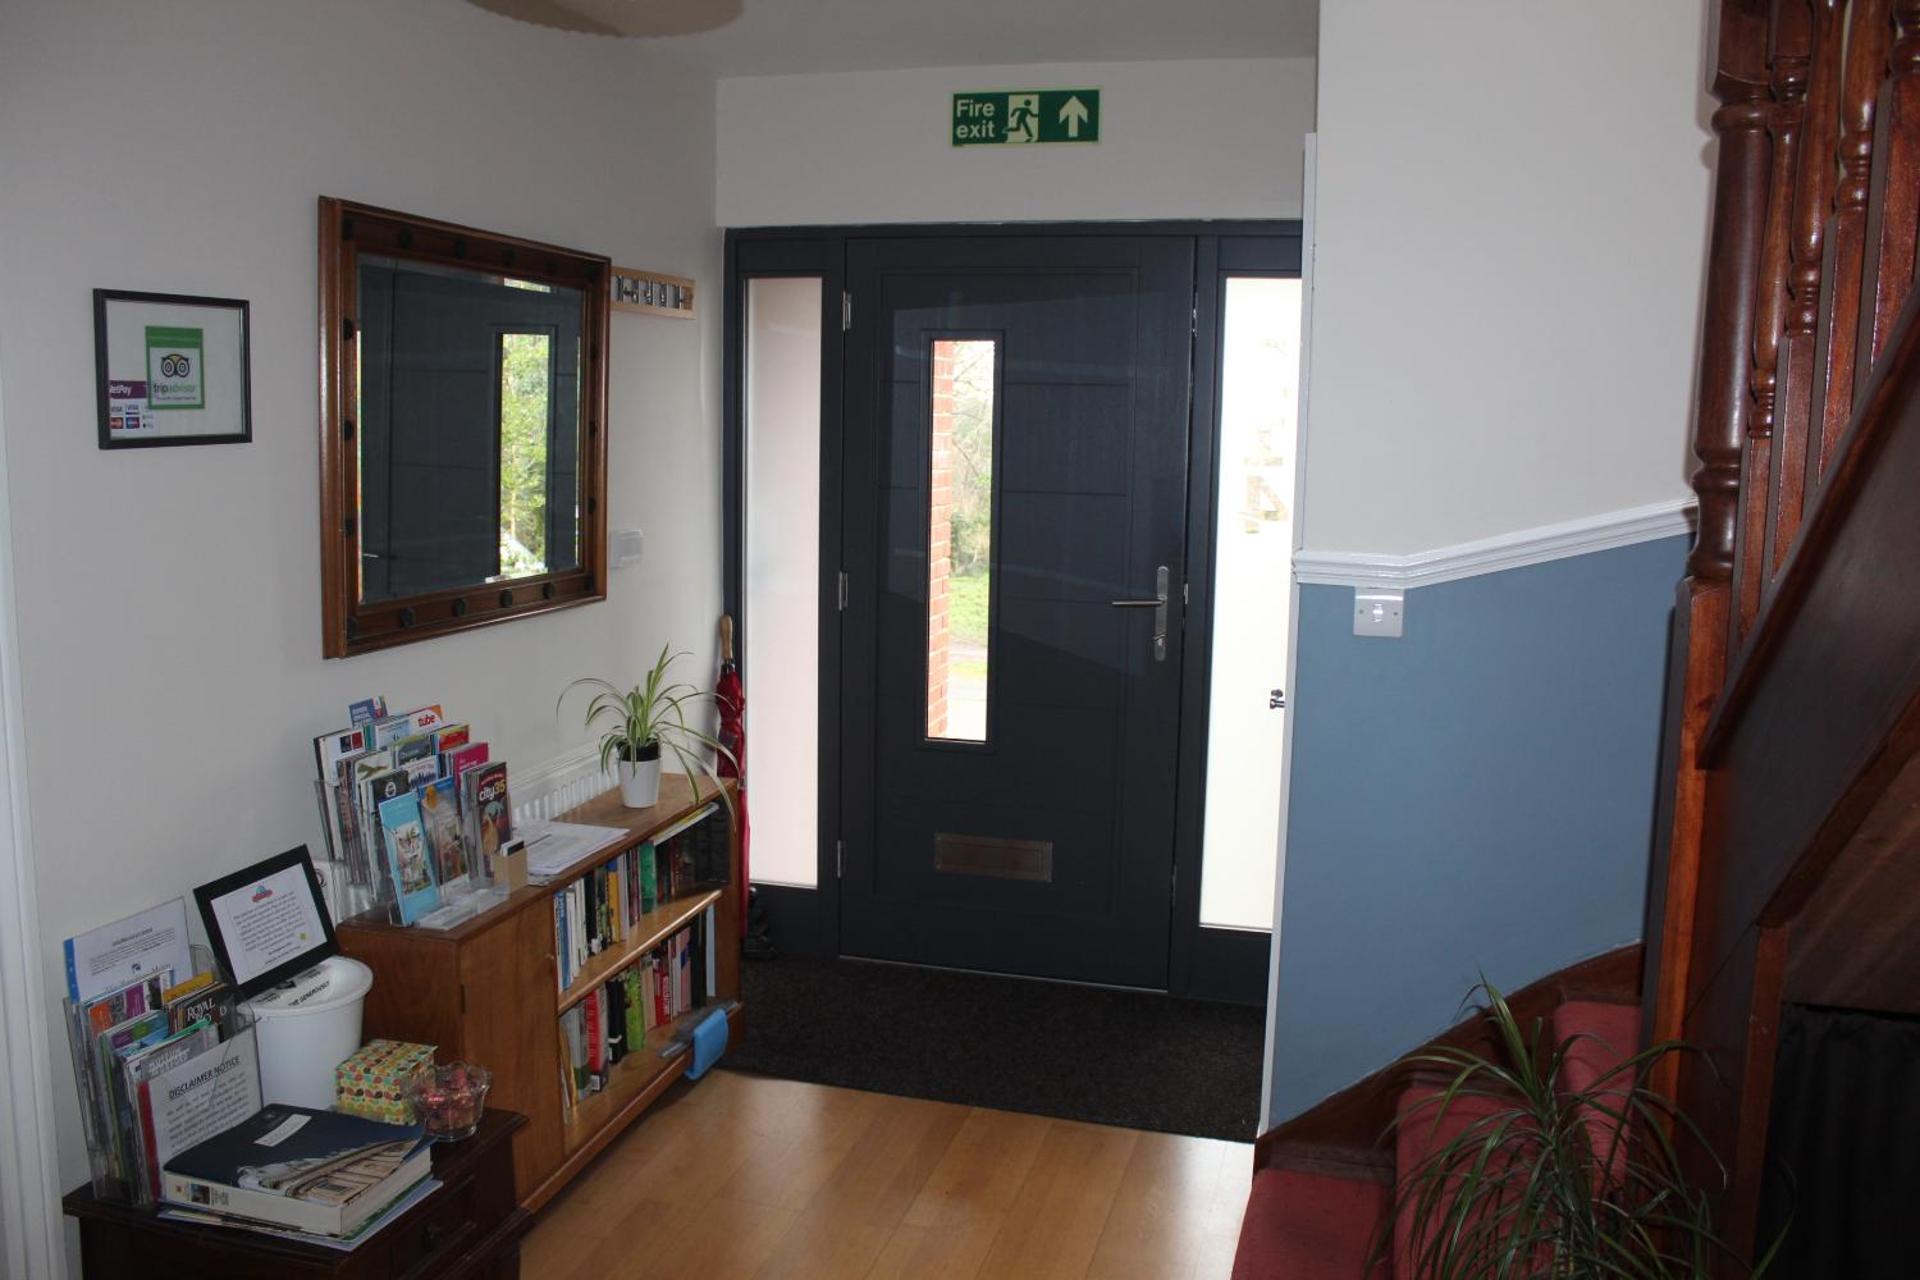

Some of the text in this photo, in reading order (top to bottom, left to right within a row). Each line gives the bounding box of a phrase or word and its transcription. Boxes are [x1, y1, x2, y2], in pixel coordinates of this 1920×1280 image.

[956, 100, 995, 118] Fire
[956, 120, 995, 138] exit
[168, 1068, 213, 1099] DISCLAIMER
[213, 1055, 241, 1077] NOTICE
